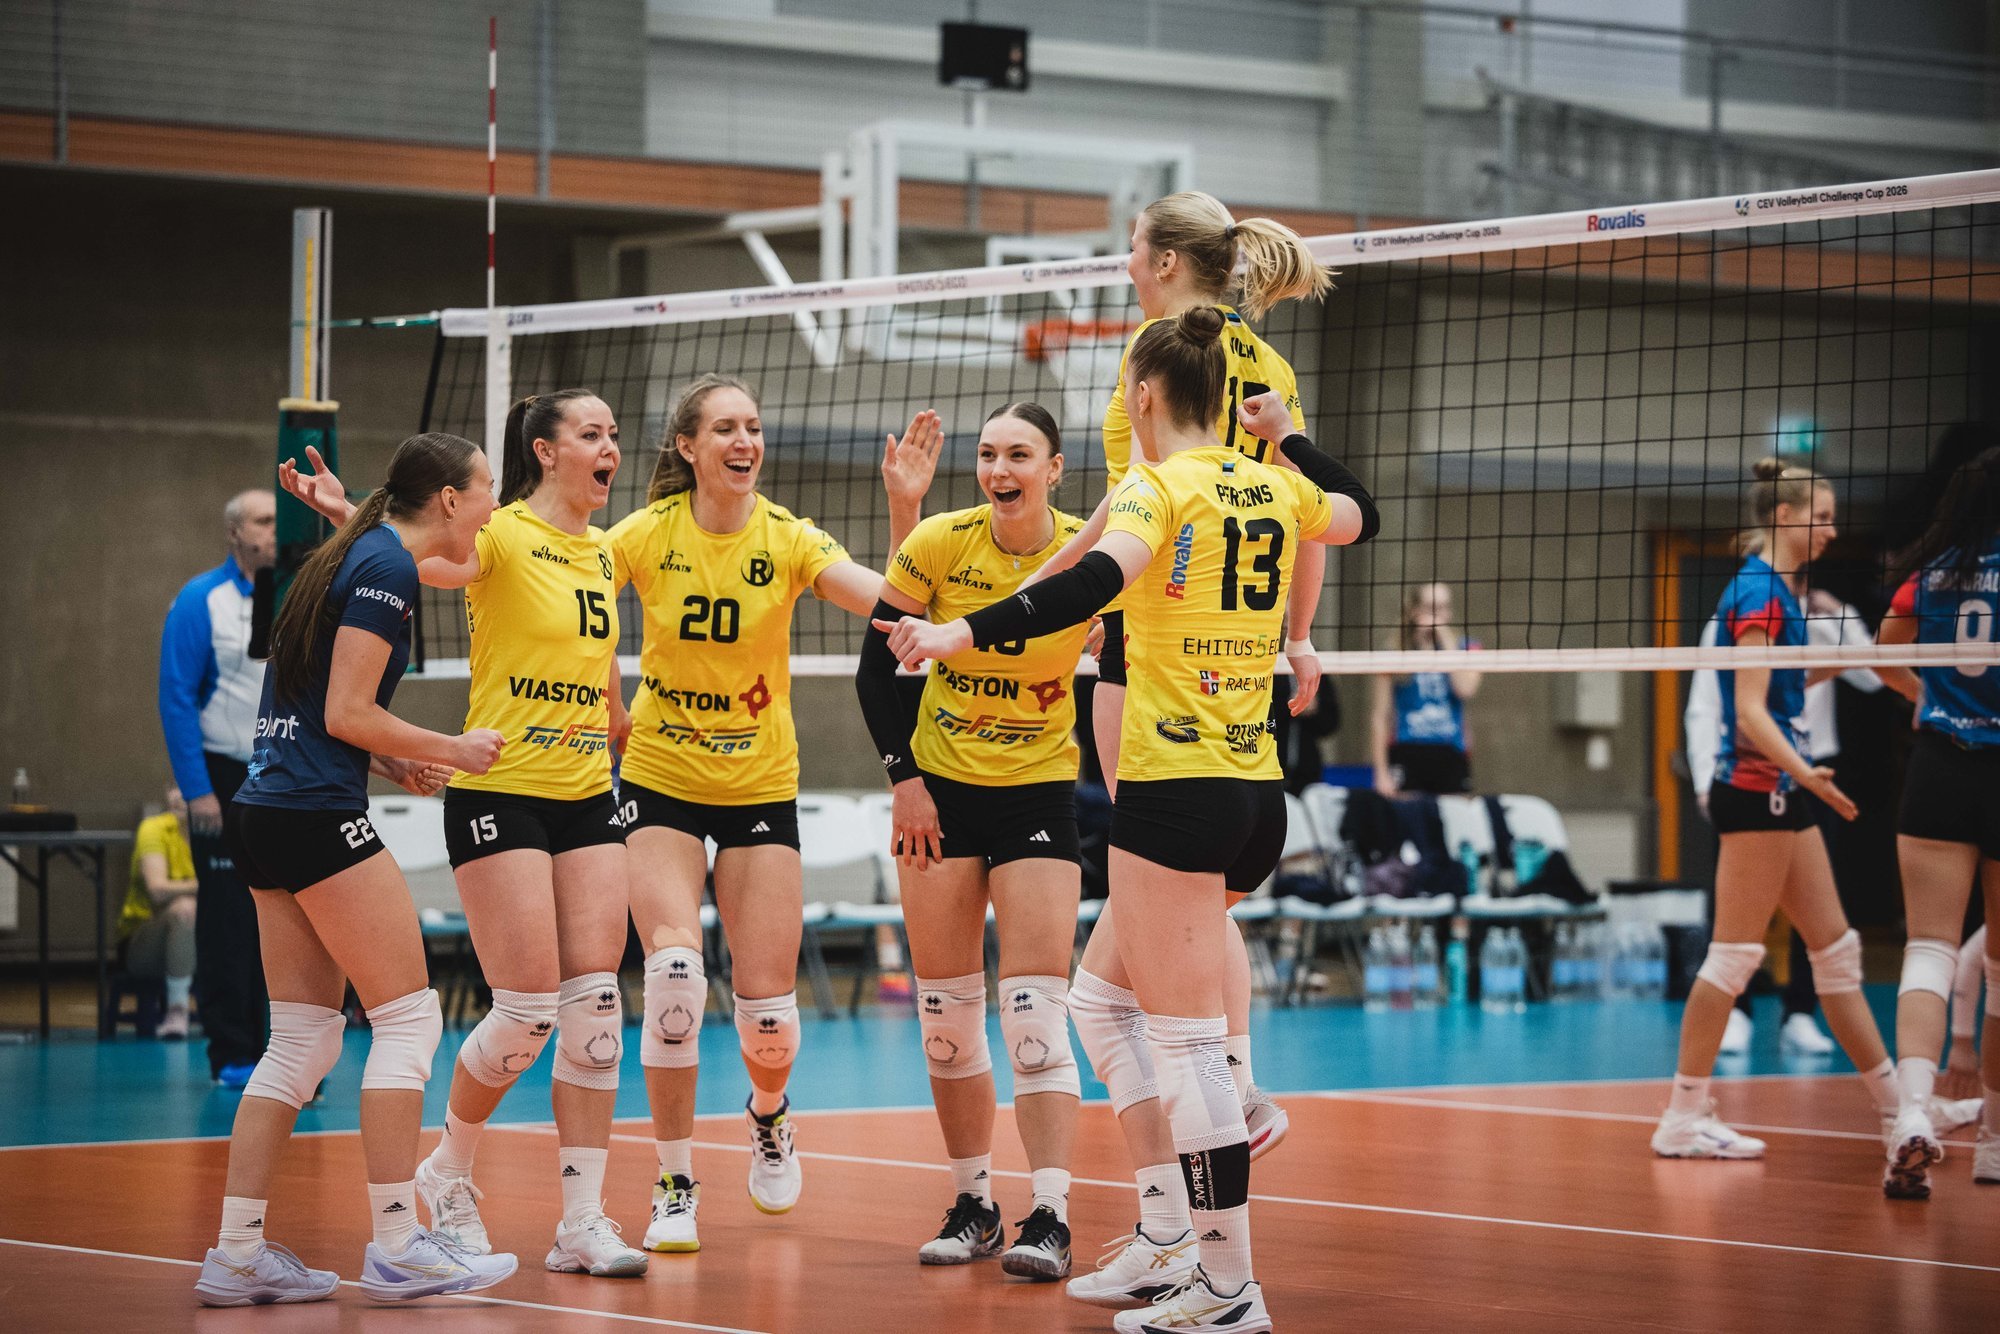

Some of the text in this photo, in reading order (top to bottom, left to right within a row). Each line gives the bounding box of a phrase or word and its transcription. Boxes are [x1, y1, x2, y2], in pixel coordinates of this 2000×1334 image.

[1756, 185, 1908, 210] CEV Volleyball Challenge Cup 2026
[1587, 209, 1646, 232] Rovalis
[1371, 226, 1502, 247] CEV Volleyball Challenge Cup 2026
[1165, 523, 1194, 600] Rovalis
[1221, 516, 1285, 611] 13
[355, 586, 406, 611] VIASTON
[575, 588, 611, 640] 15
[679, 594, 741, 644] 20
[509, 676, 603, 708] VIASTON
[1225, 677, 1252, 691] RAE
[522, 724, 607, 755] TarFurgo
[935, 706, 1040, 745] TarFurgo
[339, 817, 376, 850] 22
[470, 814, 499, 845] 15
